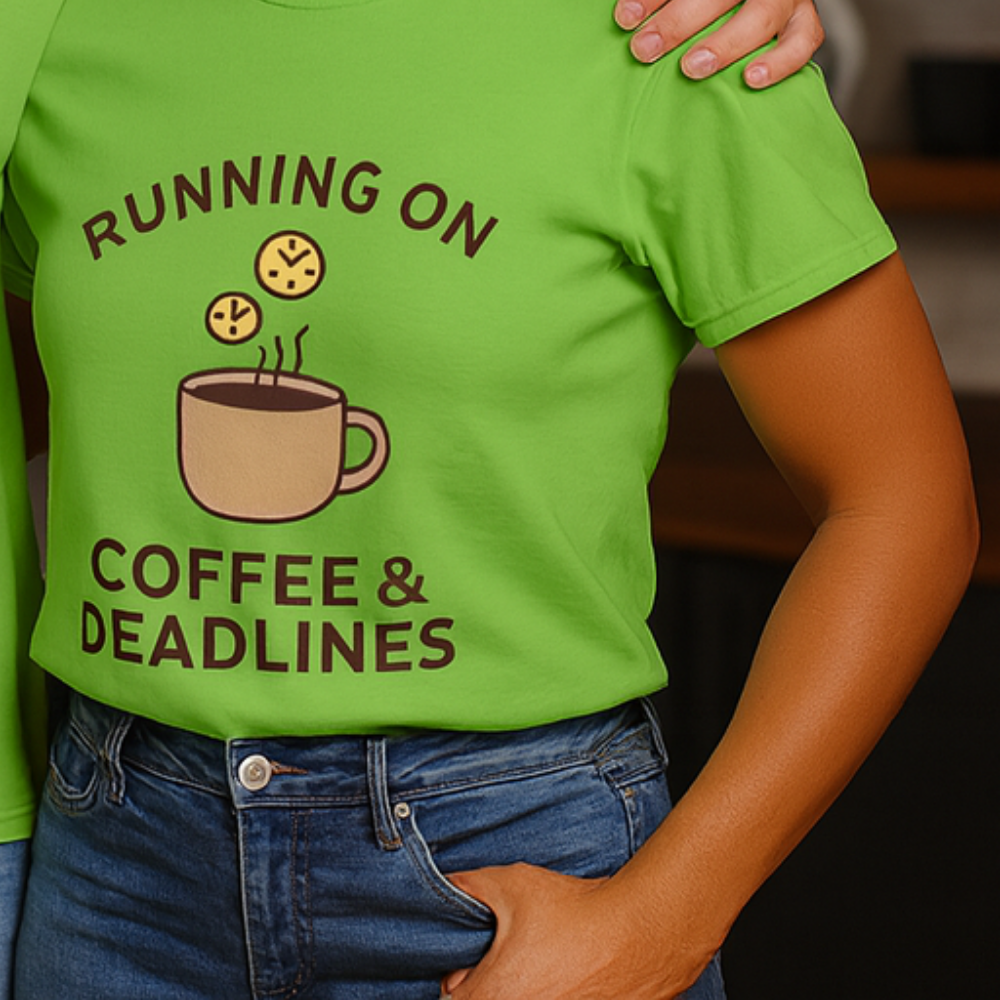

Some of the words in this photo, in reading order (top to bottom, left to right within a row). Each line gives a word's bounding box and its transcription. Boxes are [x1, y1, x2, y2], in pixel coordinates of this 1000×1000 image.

[81, 153, 383, 262] RUNNING
[399, 181, 500, 260] ON
[89, 536, 360, 608] COFFEE
[376, 555, 430, 609] &
[80, 599, 457, 674] DEADLINES
